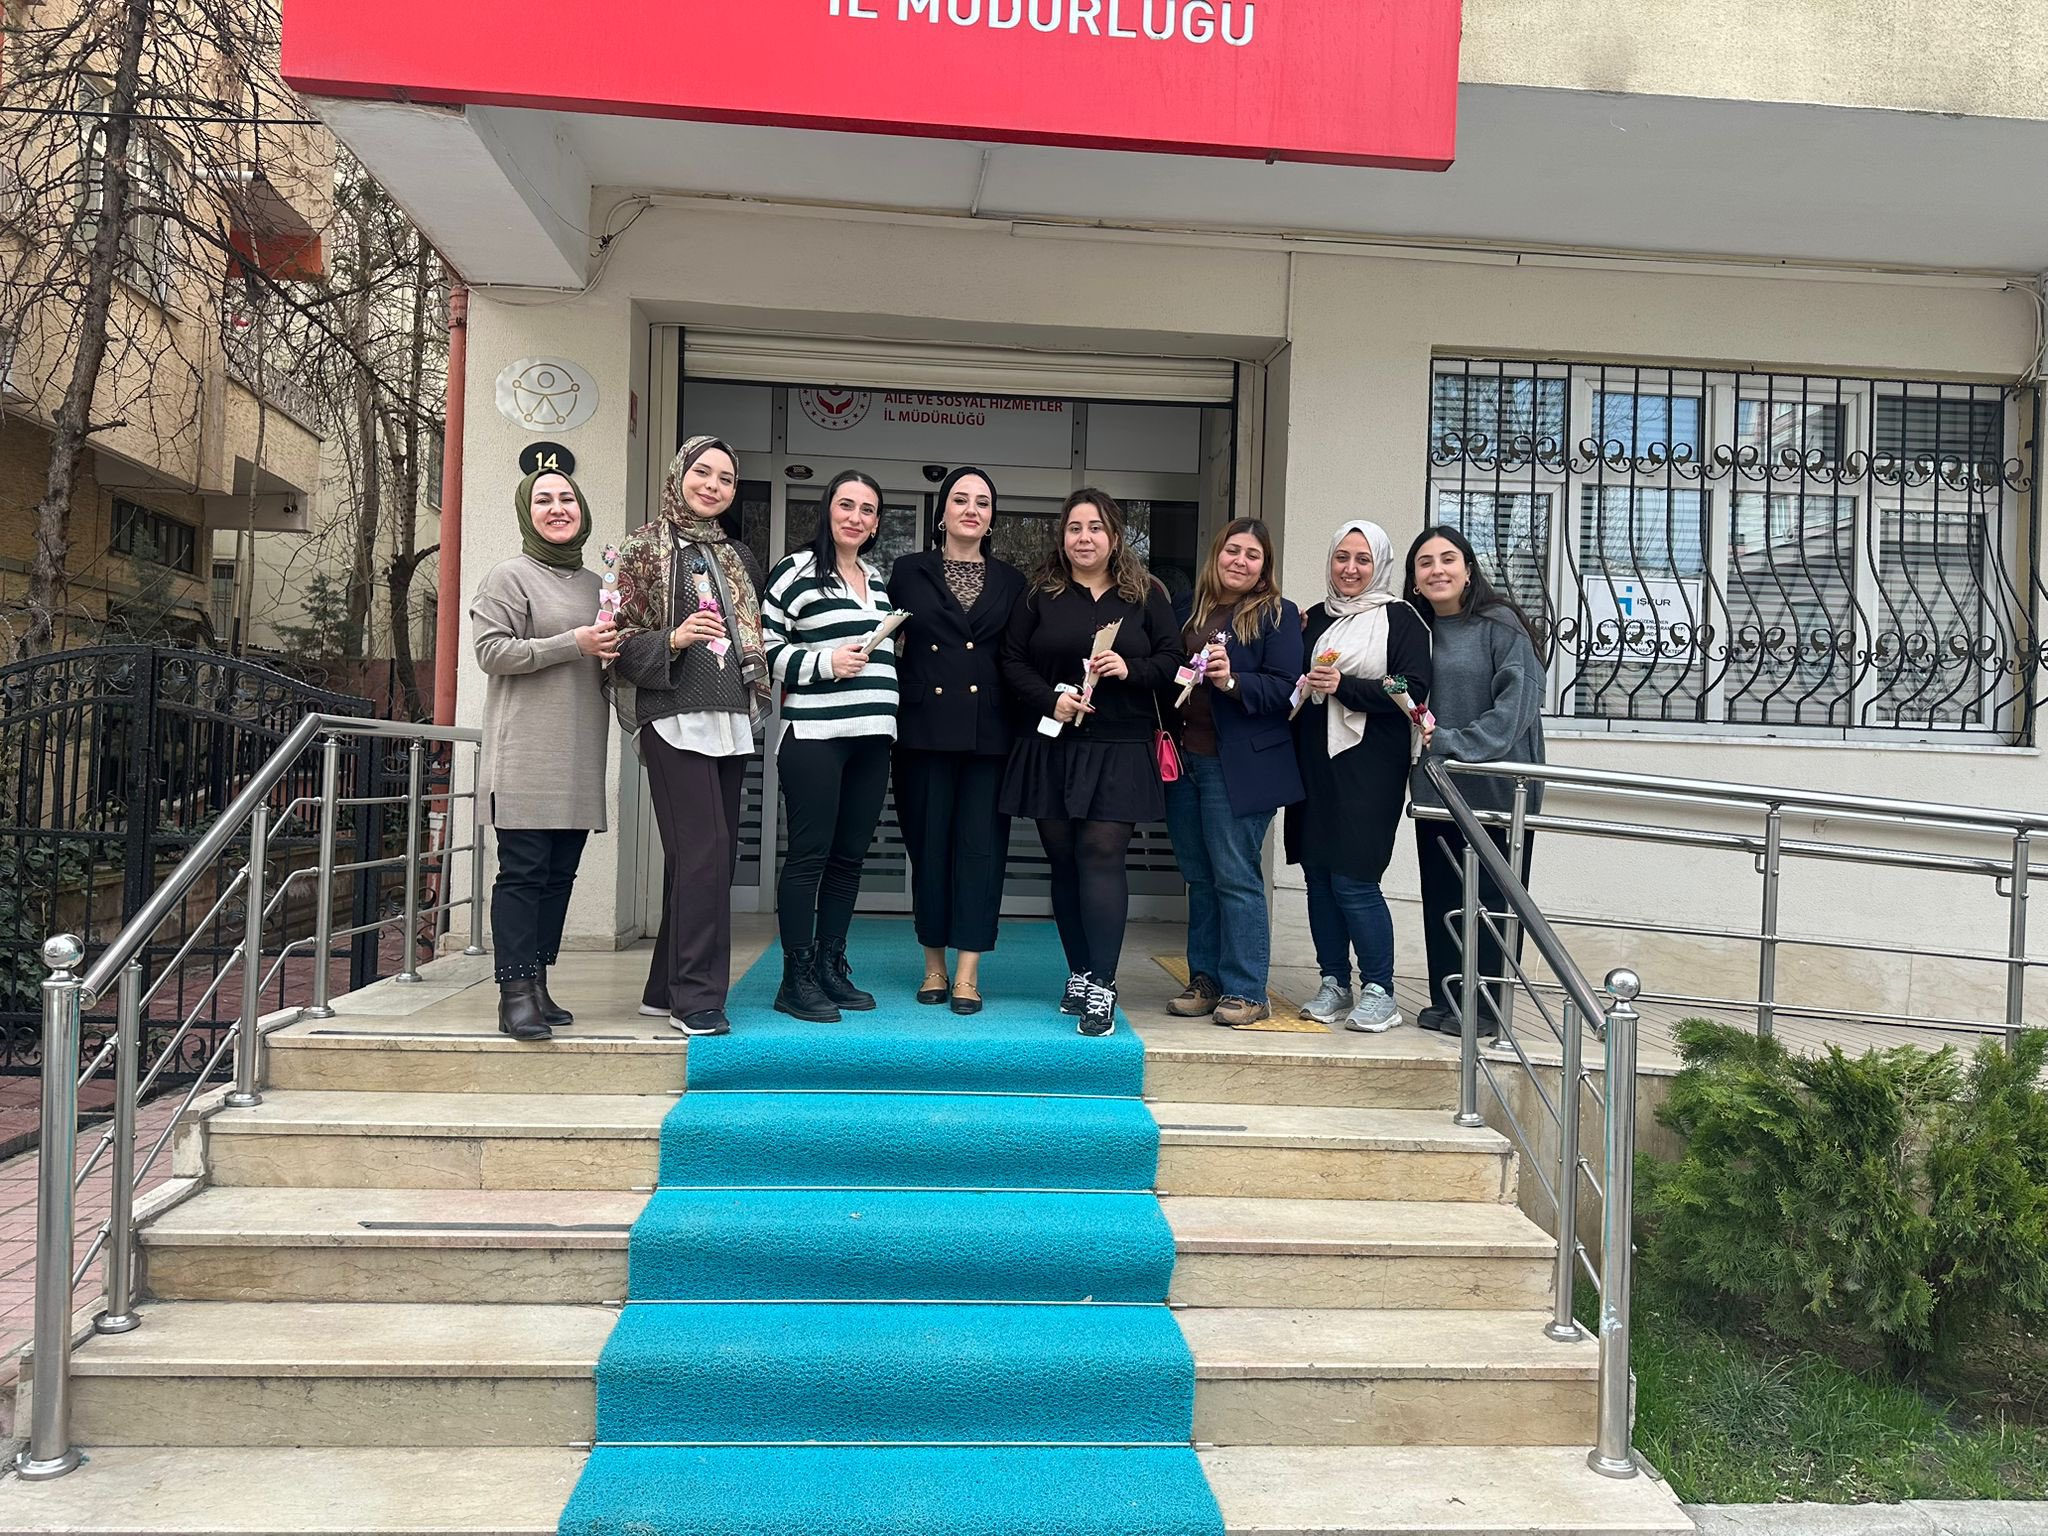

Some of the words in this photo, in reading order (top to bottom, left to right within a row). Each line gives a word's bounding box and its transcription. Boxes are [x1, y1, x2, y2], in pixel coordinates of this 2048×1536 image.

[916, 394, 933, 406] VE
[937, 396, 986, 409] SOSYAL
[884, 408, 895, 421] İL
[899, 409, 985, 426] MÜDÜRLÜĞÜ
[535, 452, 559, 470] 14
